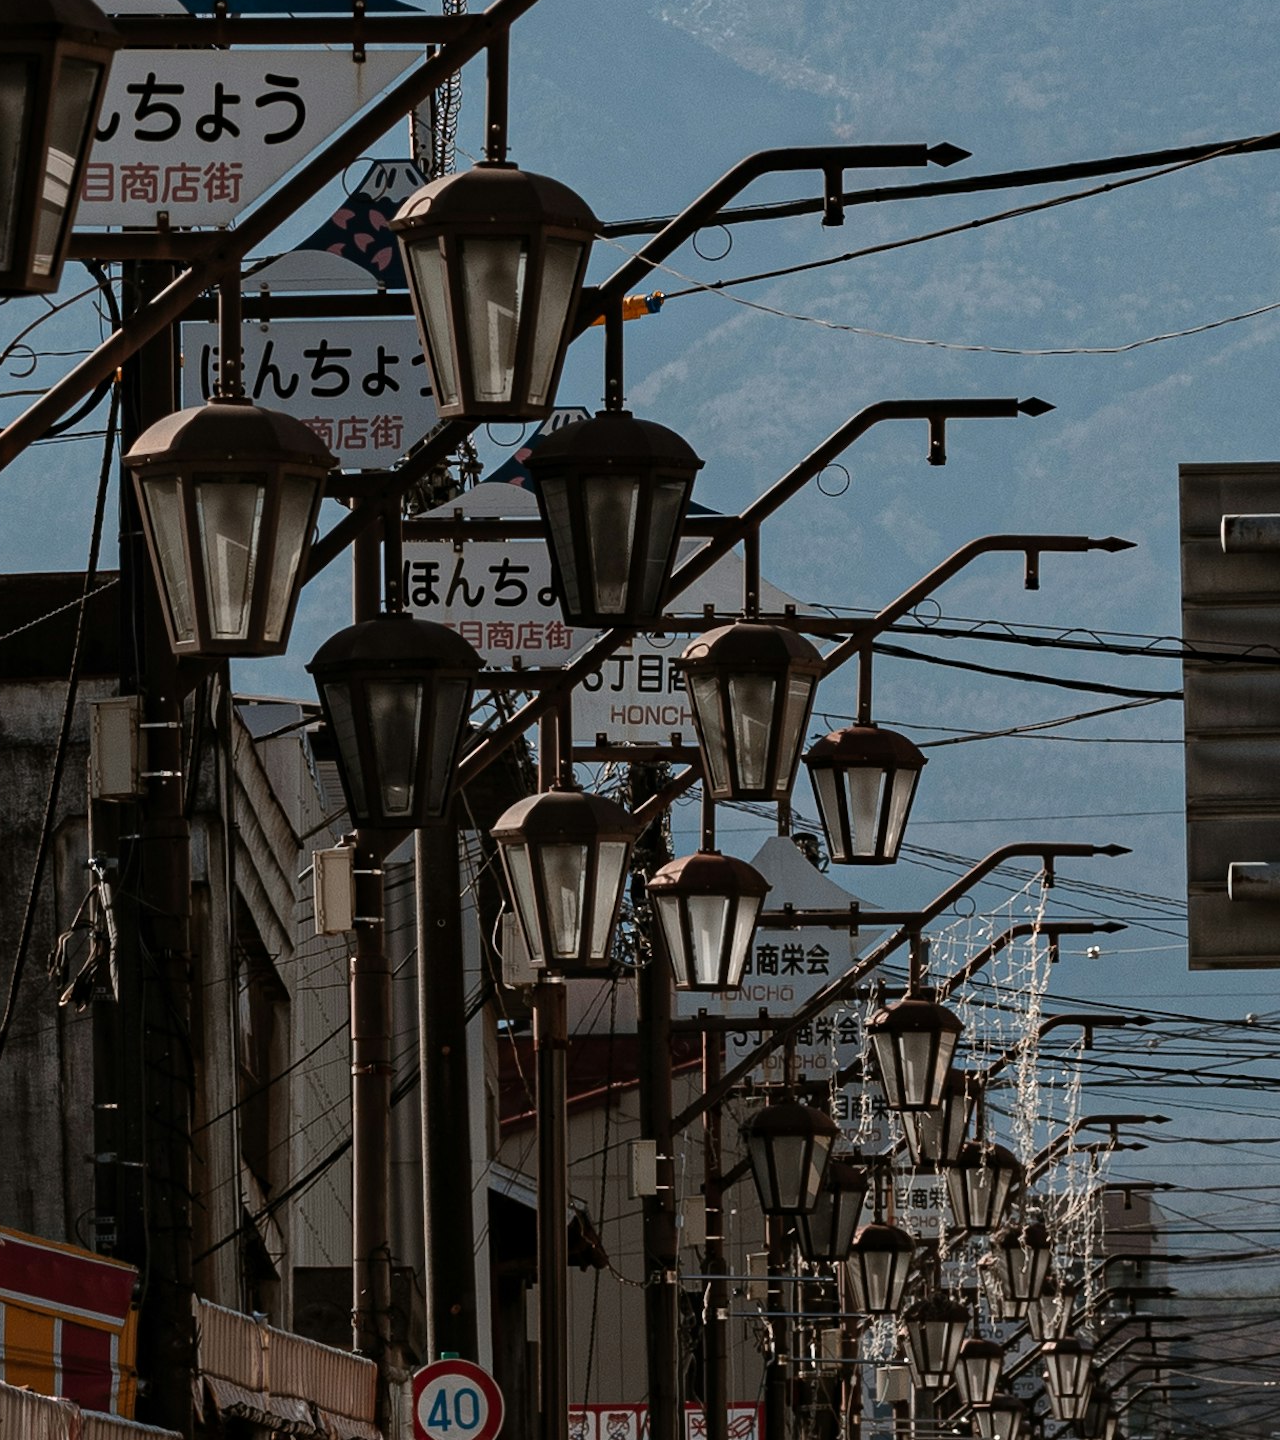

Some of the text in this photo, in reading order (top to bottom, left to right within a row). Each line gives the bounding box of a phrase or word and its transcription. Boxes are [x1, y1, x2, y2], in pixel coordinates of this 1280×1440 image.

[93, 72, 306, 144] ちょう
[744, 943, 830, 976] 商栄会
[426, 1387, 481, 1432] 40
